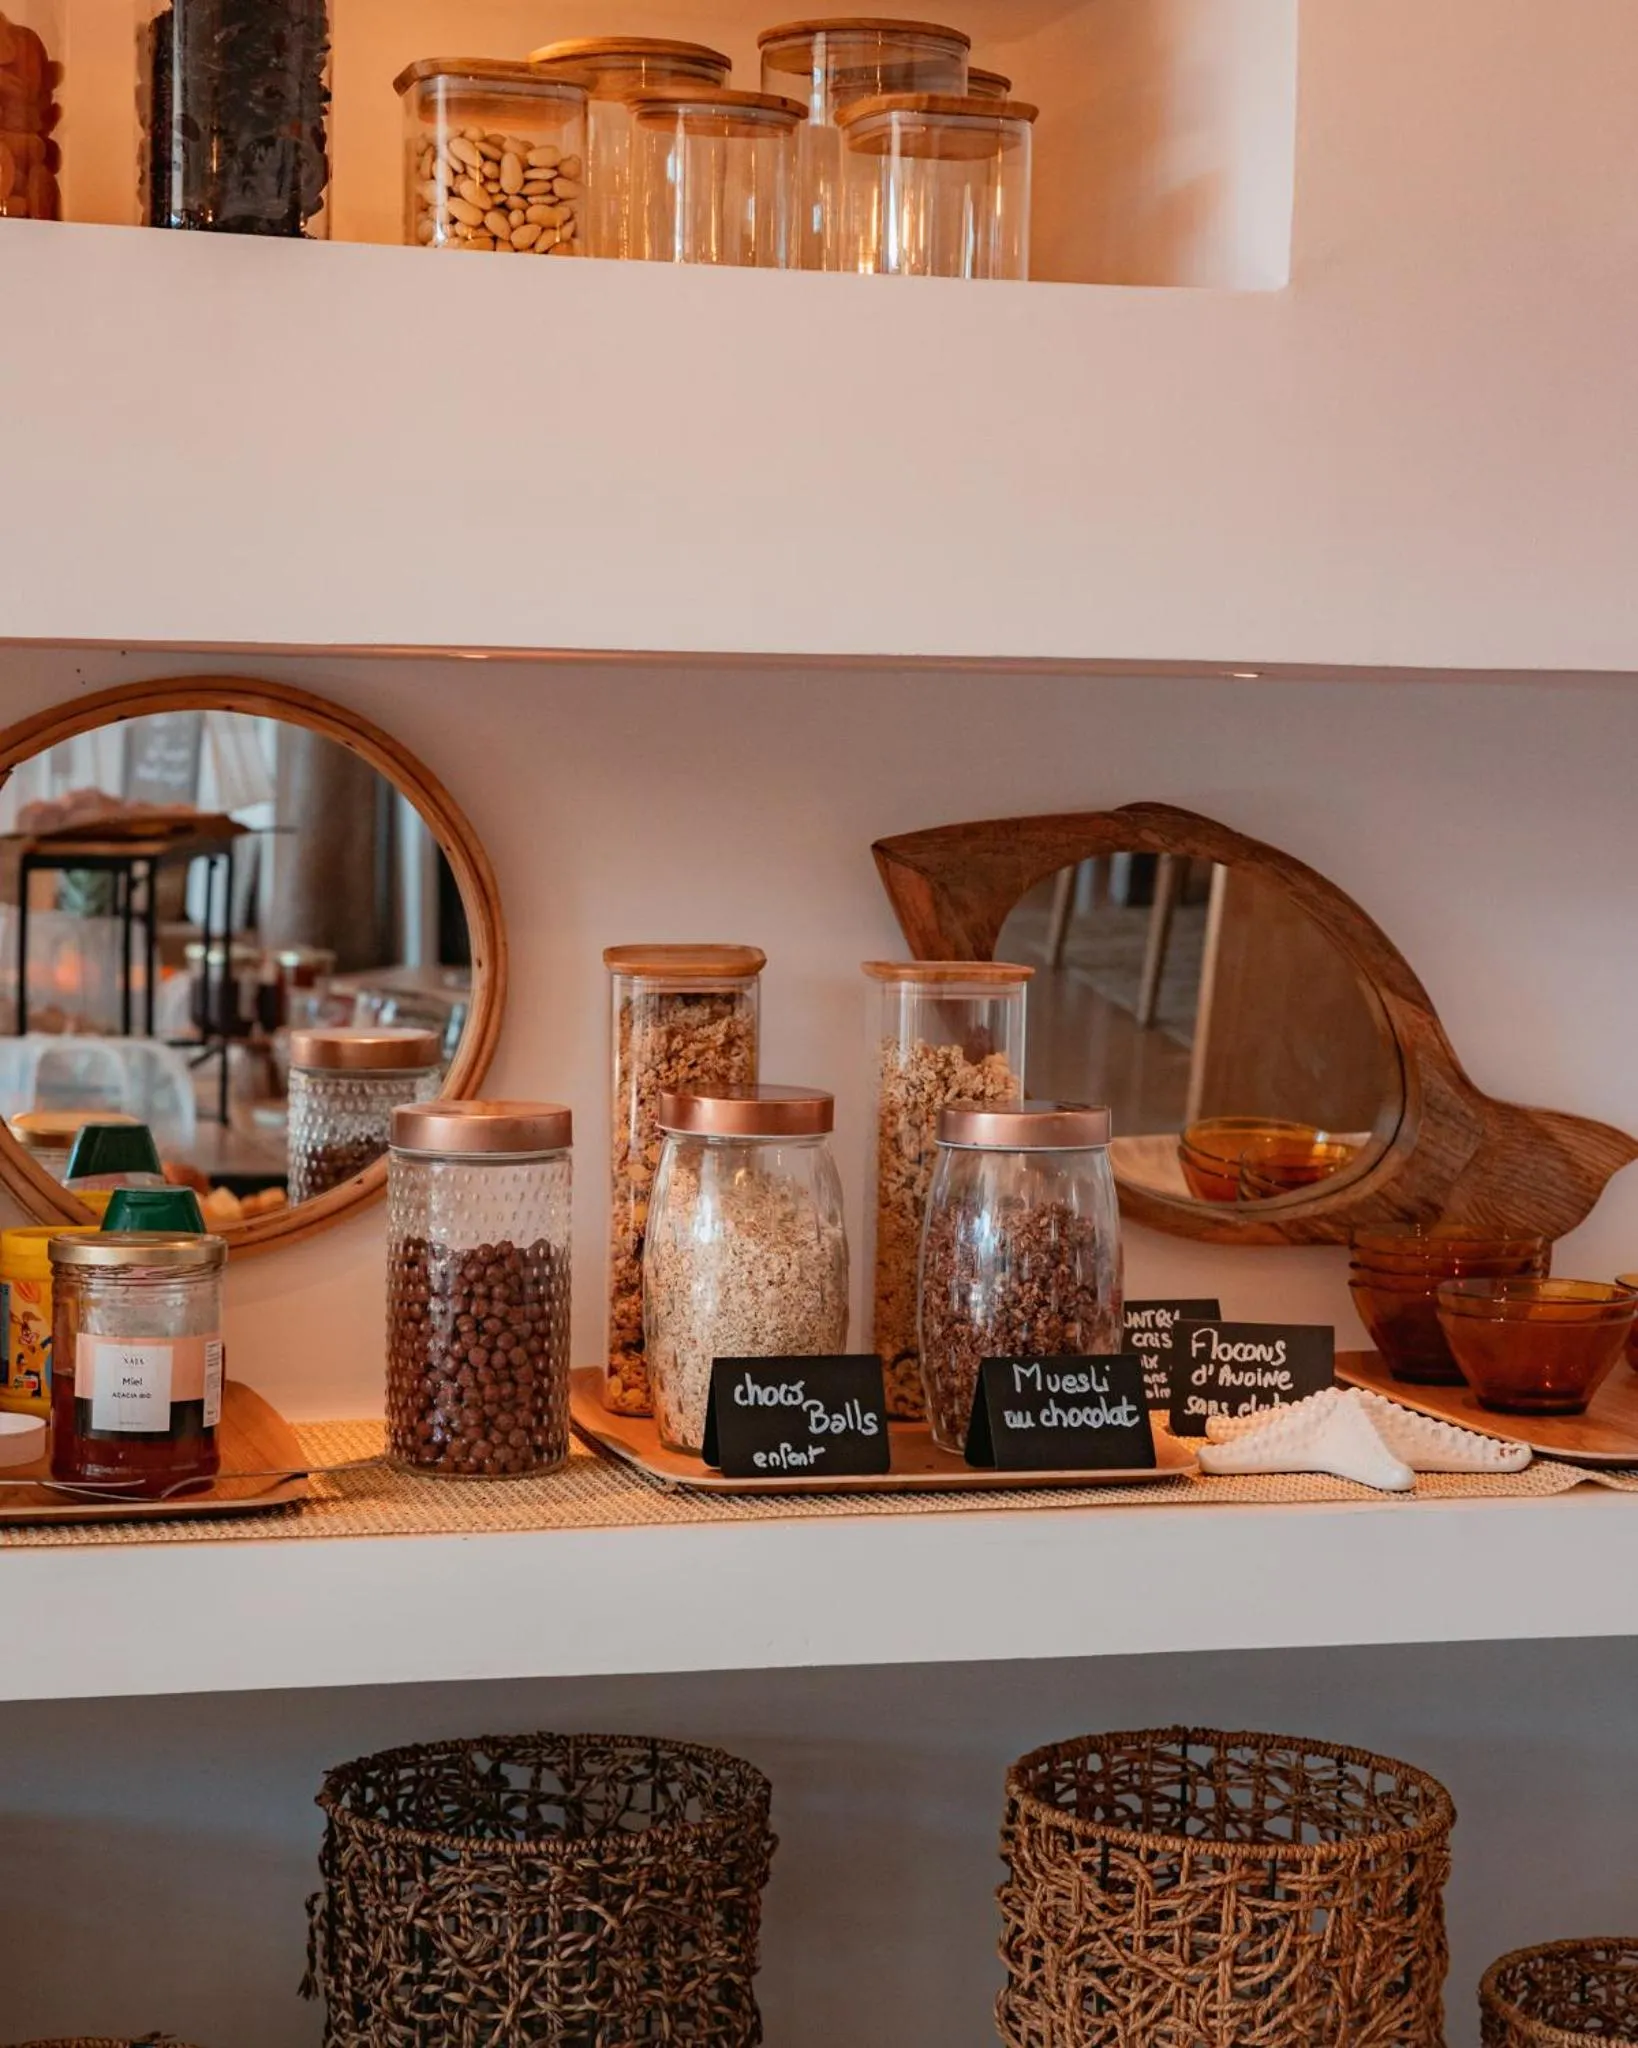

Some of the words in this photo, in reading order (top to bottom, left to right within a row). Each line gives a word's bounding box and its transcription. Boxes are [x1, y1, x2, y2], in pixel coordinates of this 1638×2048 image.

[1191, 1327, 1287, 1366] Flocons
[1013, 1362, 1110, 1394] Muesli
[802, 1399, 879, 1435] Balls
[1004, 1410, 1035, 1428] au
[1040, 1395, 1140, 1428] chocolat
